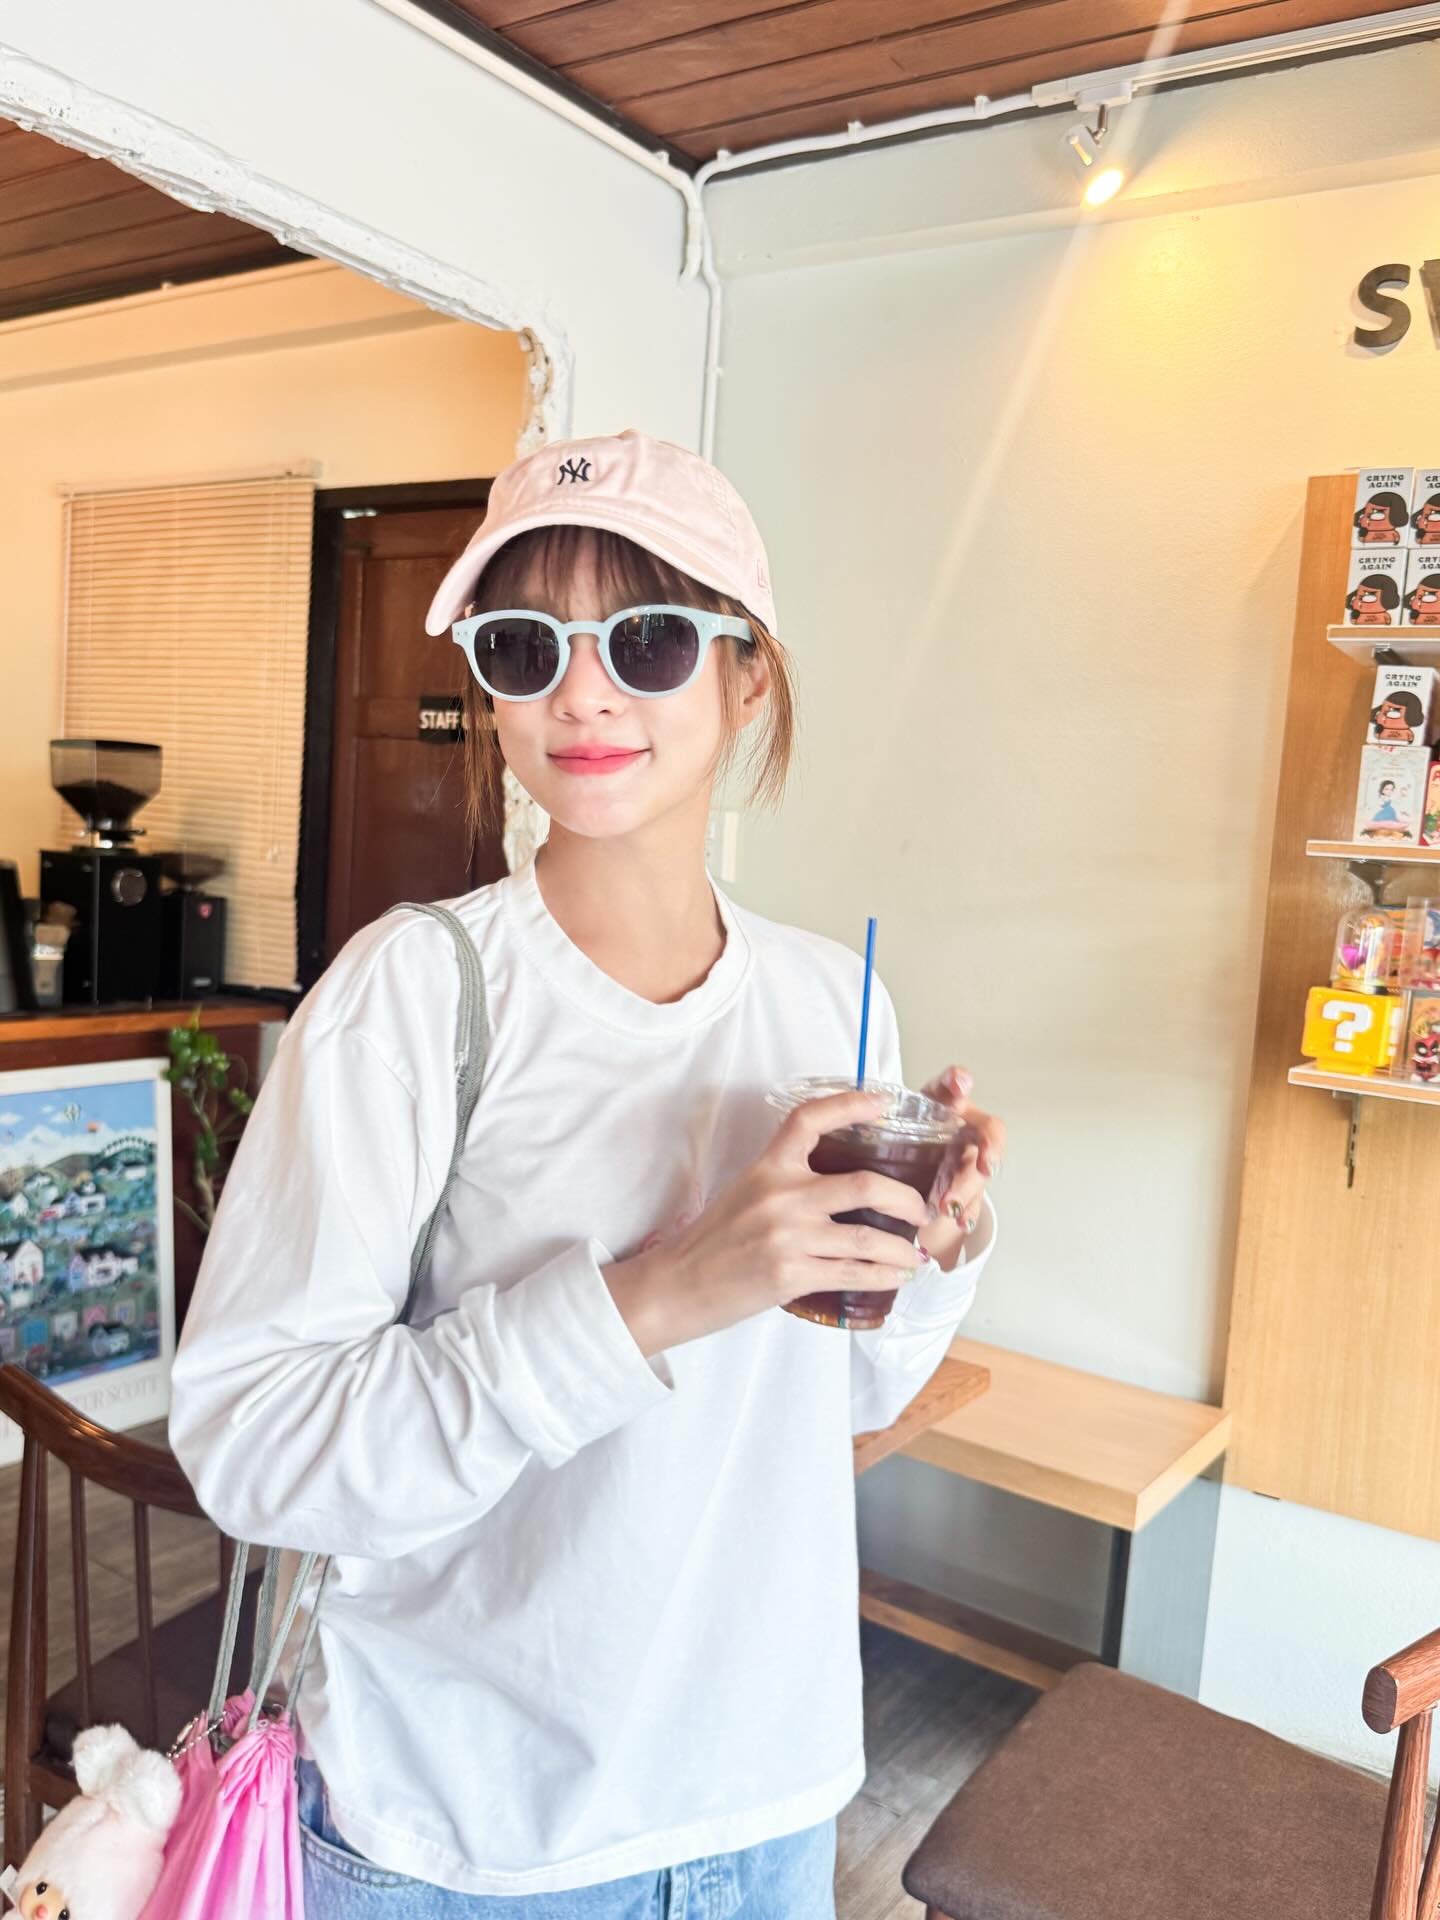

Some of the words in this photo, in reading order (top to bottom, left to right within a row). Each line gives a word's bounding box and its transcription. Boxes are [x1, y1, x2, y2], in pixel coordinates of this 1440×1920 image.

[1366, 474, 1405, 482] CRYING
[1368, 481, 1401, 489] AGAIN
[1359, 556, 1396, 564] CRYING
[419, 711, 460, 730] STAFF
